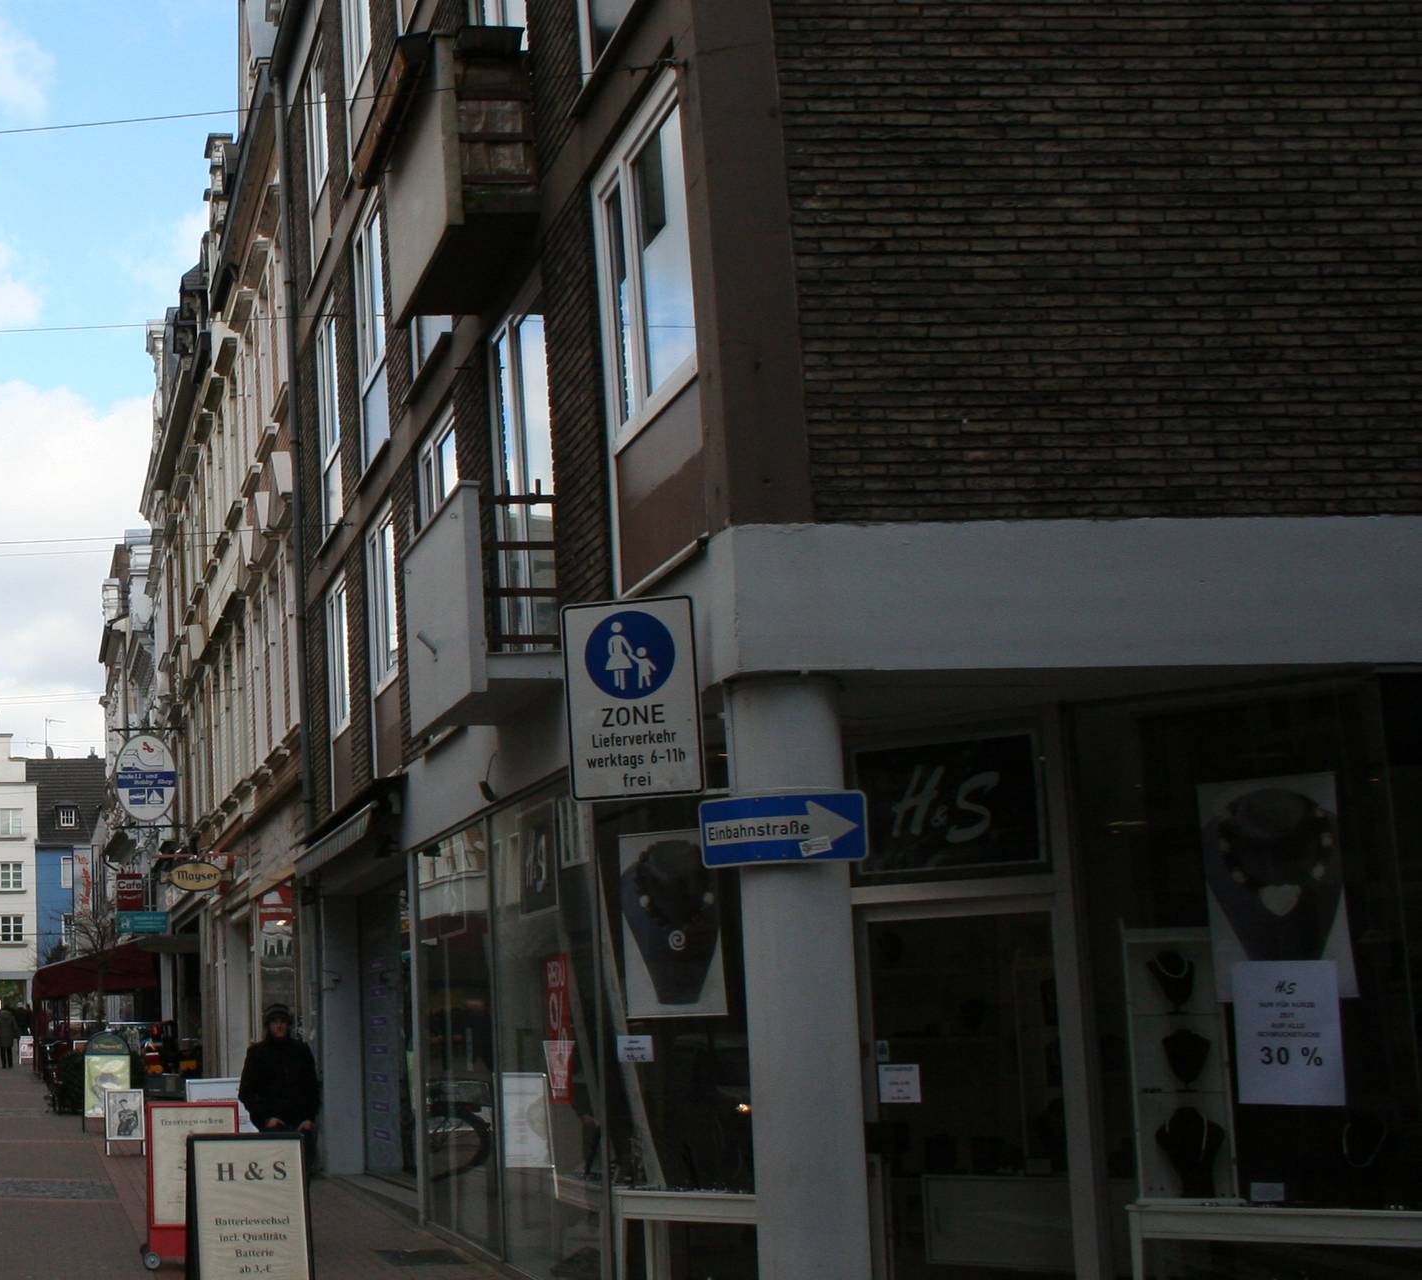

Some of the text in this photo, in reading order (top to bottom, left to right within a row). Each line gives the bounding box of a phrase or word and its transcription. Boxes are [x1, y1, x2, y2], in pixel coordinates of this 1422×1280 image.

[601, 704, 665, 728] ZONE
[591, 730, 677, 749] Lieferverkehr
[586, 748, 686, 769] werktags 6-11h
[623, 773, 652, 788] frei
[708, 820, 810, 841] Einbahnstraße
[176, 871, 219, 883] Mayser
[1260, 1046, 1323, 1066] 30 %
[216, 1161, 288, 1181] H & S
[214, 1215, 290, 1226] Batteriewechsel
[242, 1232, 288, 1243] Qualitäts
[235, 1248, 274, 1258] Batterie
[239, 1264, 251, 1273] ab
